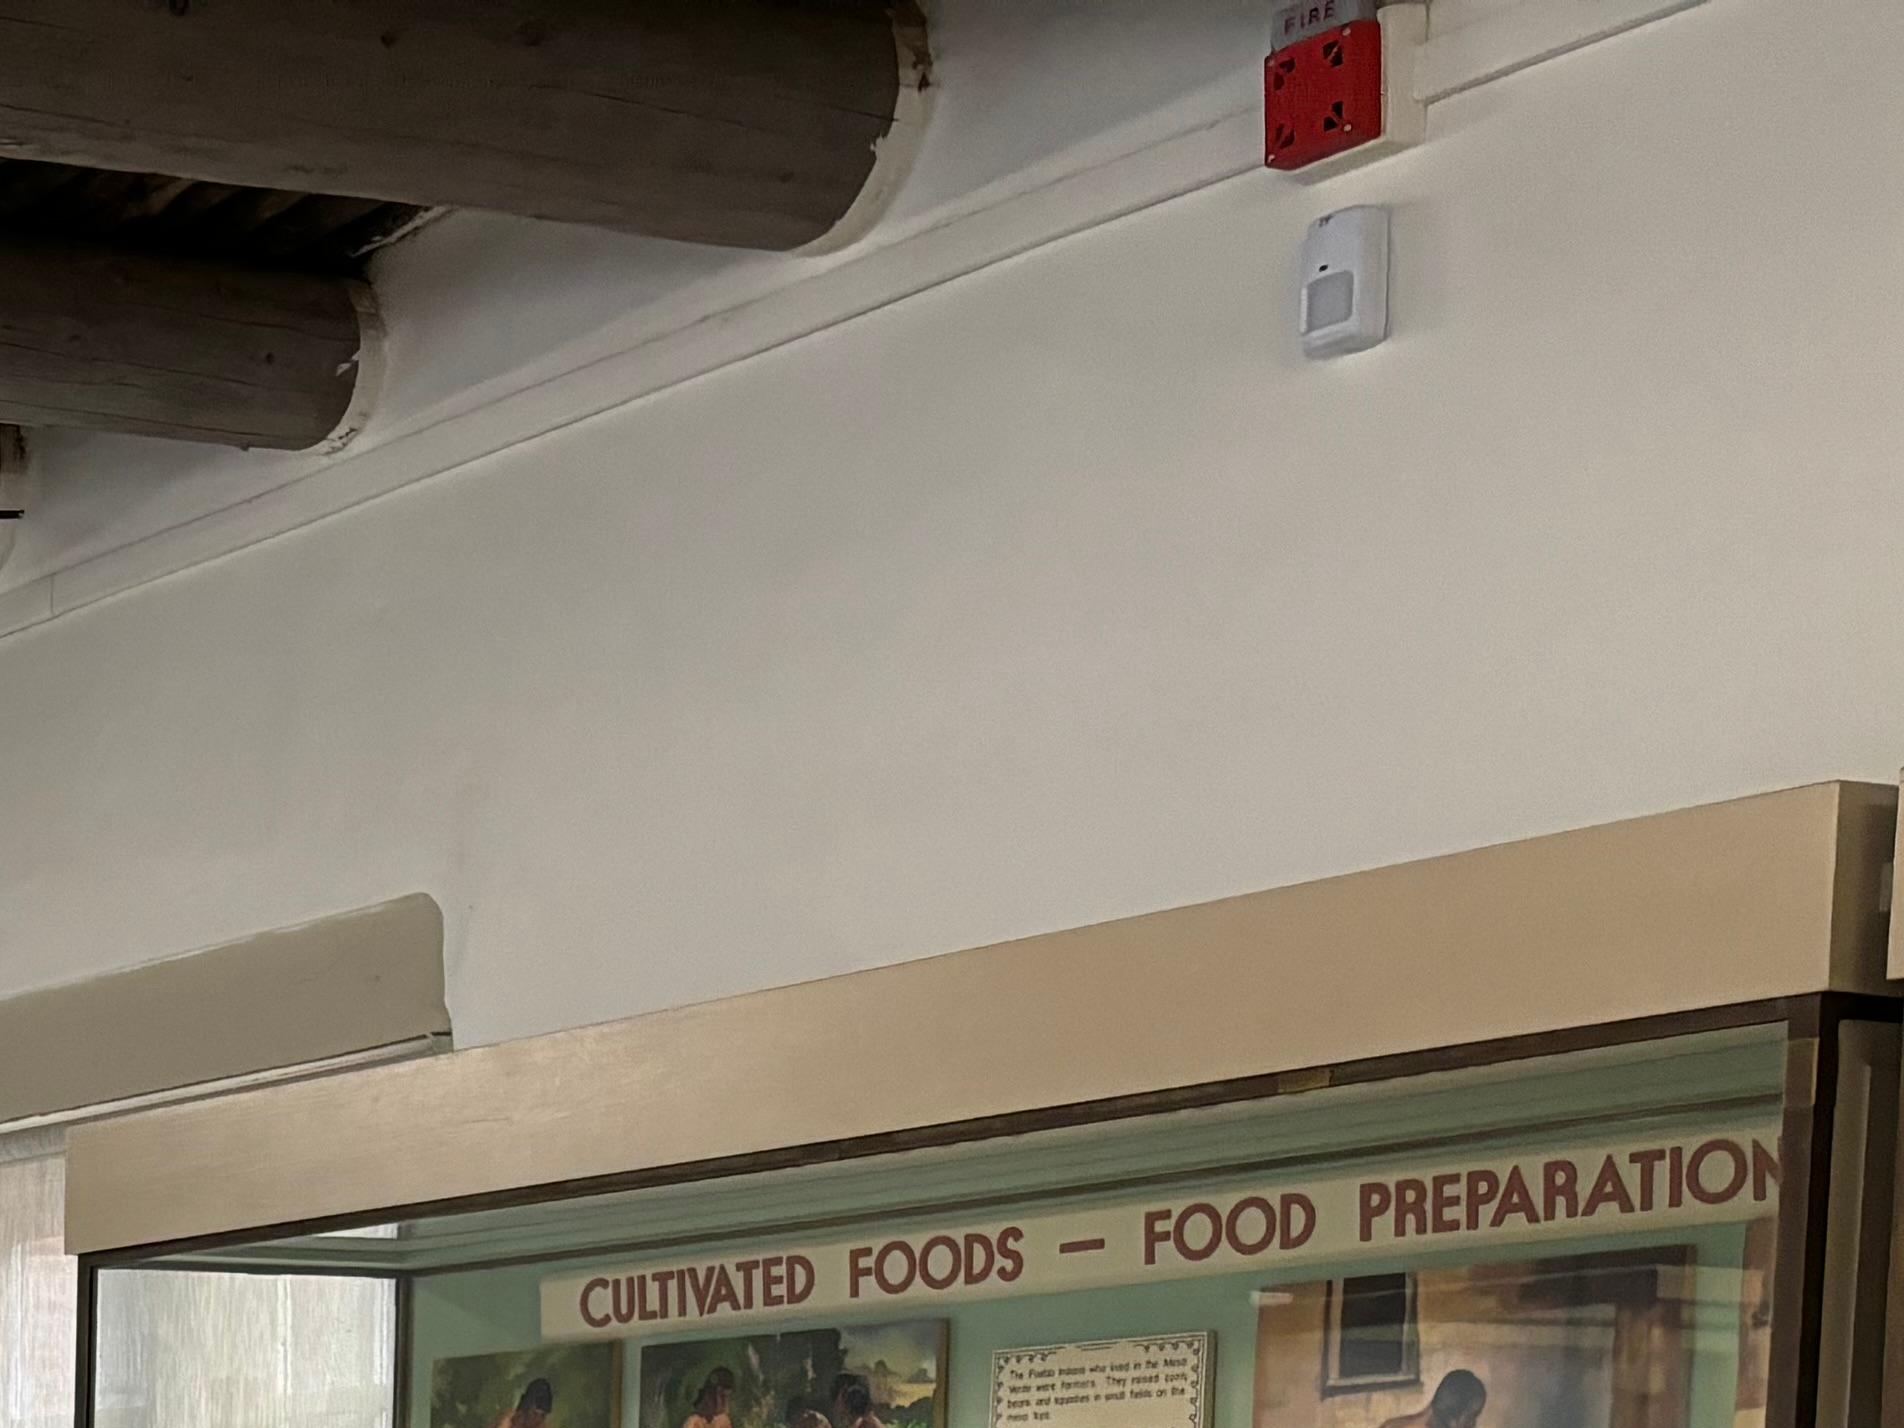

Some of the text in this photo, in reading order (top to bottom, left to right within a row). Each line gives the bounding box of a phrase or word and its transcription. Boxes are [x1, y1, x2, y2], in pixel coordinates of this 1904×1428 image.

[1284, 0, 1336, 35] FIRE
[579, 1254, 815, 1328] CULTIVATED
[849, 1226, 1024, 1298] FOODS
[1143, 1192, 1317, 1265] FOOD
